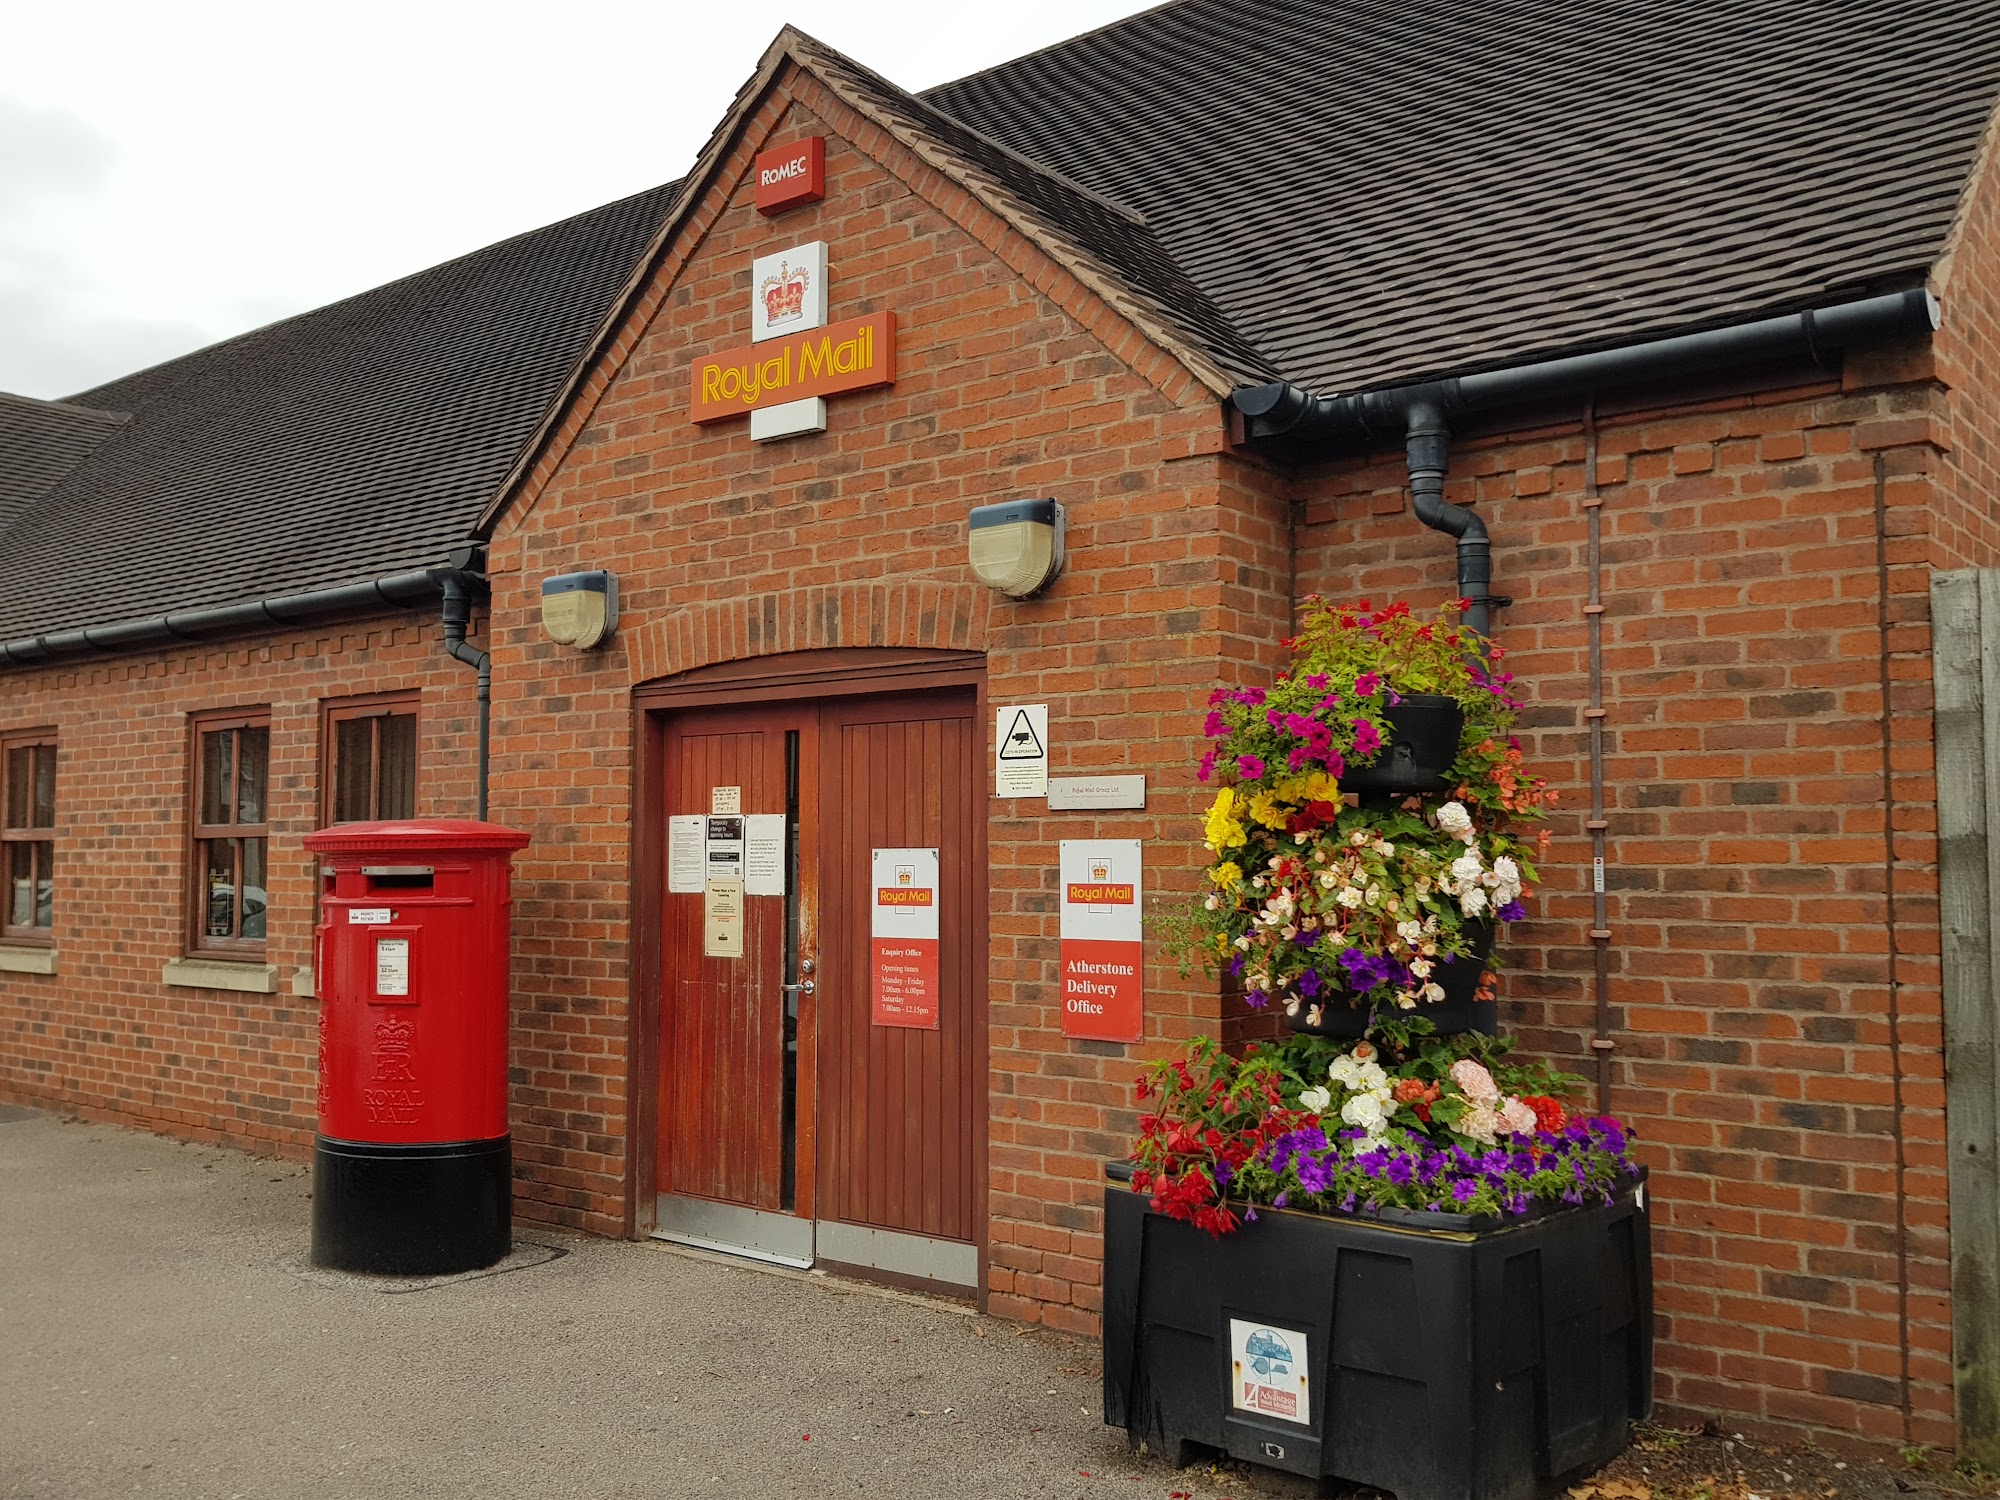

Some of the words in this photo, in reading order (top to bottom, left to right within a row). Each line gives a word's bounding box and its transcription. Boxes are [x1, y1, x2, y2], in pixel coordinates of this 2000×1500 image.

[761, 156, 806, 186] ROMEC
[702, 346, 790, 404] Royal
[798, 325, 873, 384] Mail
[880, 890, 906, 904] Royal
[908, 890, 930, 902] Mail
[1070, 886, 1102, 902] Royal
[1104, 886, 1131, 900] Mail
[881, 948, 904, 957] Enquiry
[905, 949, 922, 957] Office
[881, 964, 903, 973] Opening
[1067, 960, 1134, 976] Atherstone
[881, 976, 903, 985] Monday
[907, 977, 925, 986] Friday
[1067, 979, 1117, 998] Delivery
[881, 985, 901, 993] 7.00am
[905, 986, 925, 996] 6.00pm
[881, 995, 904, 1004] Saturday
[1067, 998, 1104, 1015] Office
[881, 1004, 901, 1012] 7.00am
[906, 1005, 929, 1015] 12.15pm
[363, 1088, 425, 1106] ROYAL
[367, 1107, 419, 1124] MAIL
[1260, 1390, 1296, 1406] Advantage
